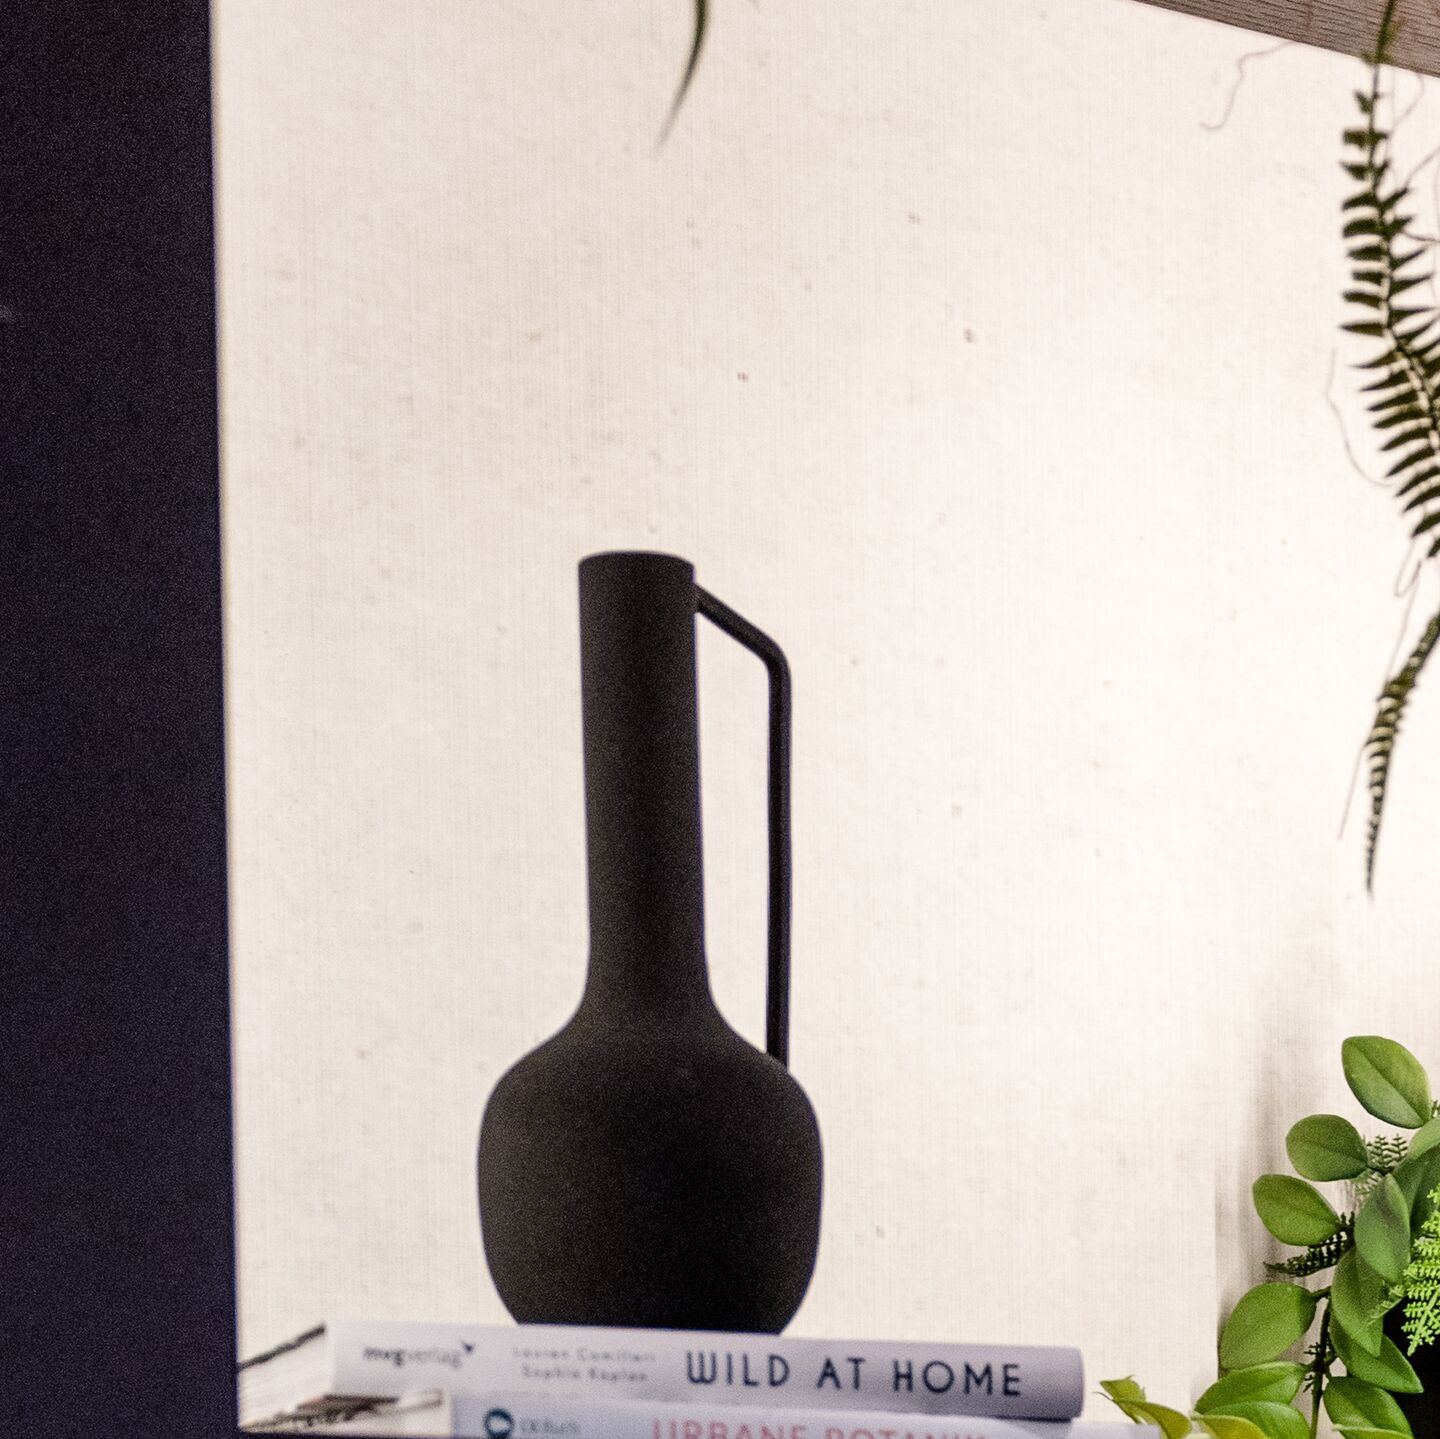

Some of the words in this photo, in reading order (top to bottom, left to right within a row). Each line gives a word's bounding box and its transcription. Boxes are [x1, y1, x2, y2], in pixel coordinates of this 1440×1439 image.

[685, 1350, 791, 1388] WILD
[816, 1357, 866, 1391] AT
[892, 1359, 1022, 1397] HOME
